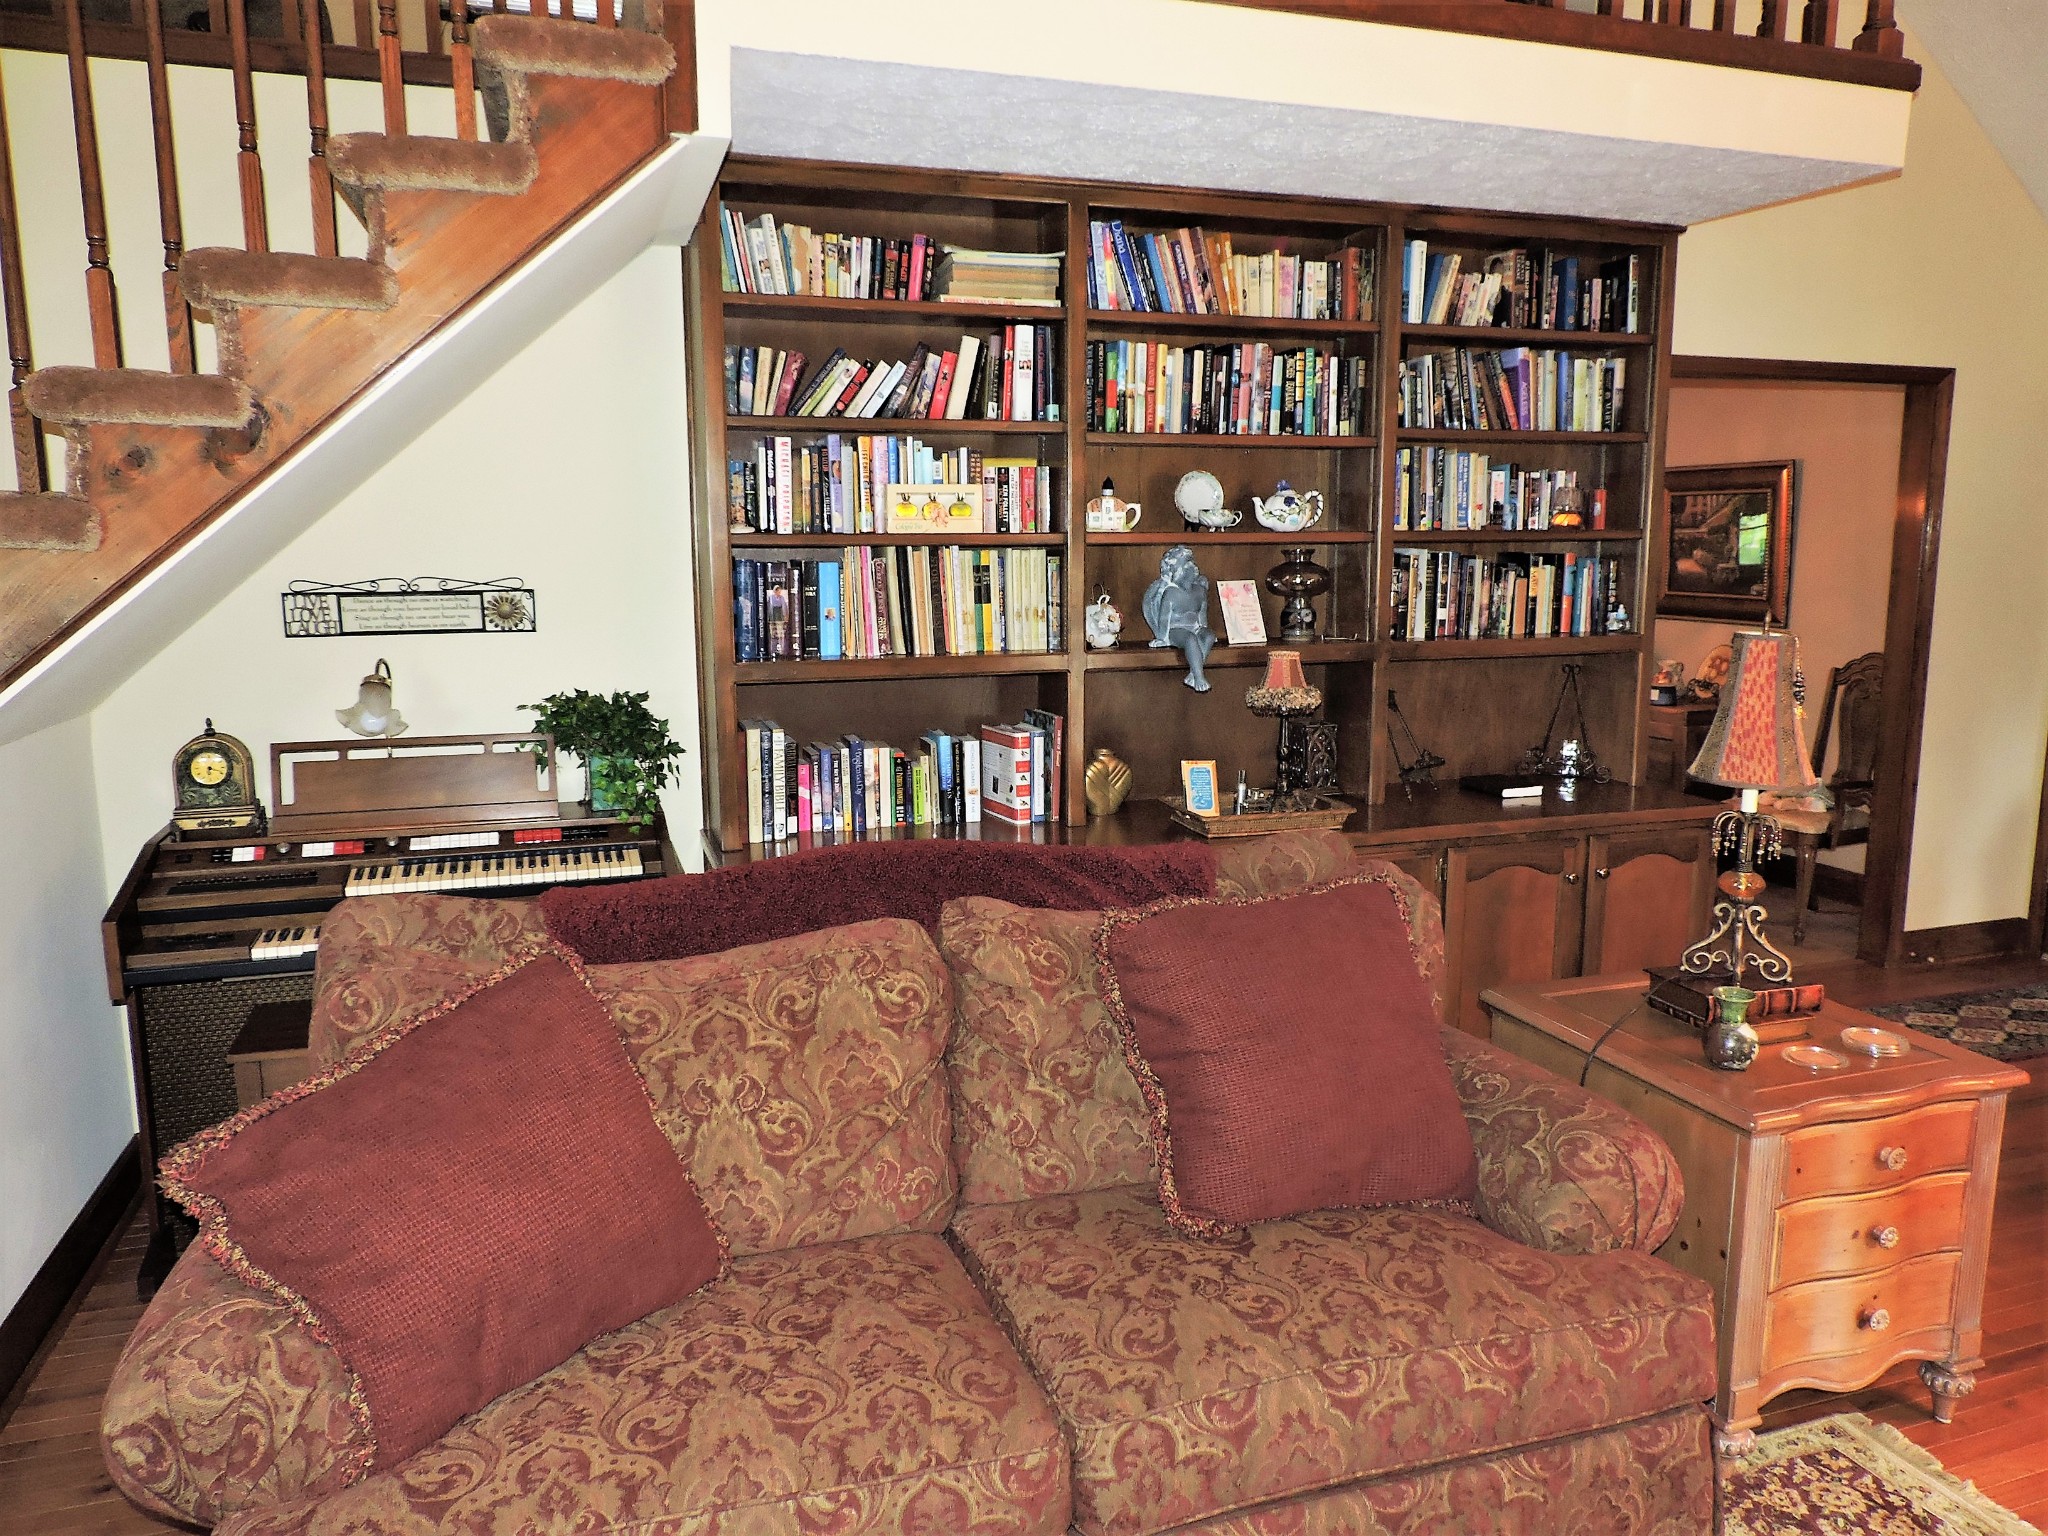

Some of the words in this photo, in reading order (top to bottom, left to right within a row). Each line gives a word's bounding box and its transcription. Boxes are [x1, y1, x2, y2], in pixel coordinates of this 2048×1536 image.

[292, 595, 330, 609] LIVE
[290, 607, 331, 622] LOVE
[287, 620, 338, 636] LAUGH
[774, 748, 784, 782] FAMILY
[775, 784, 785, 811] BIBLE
